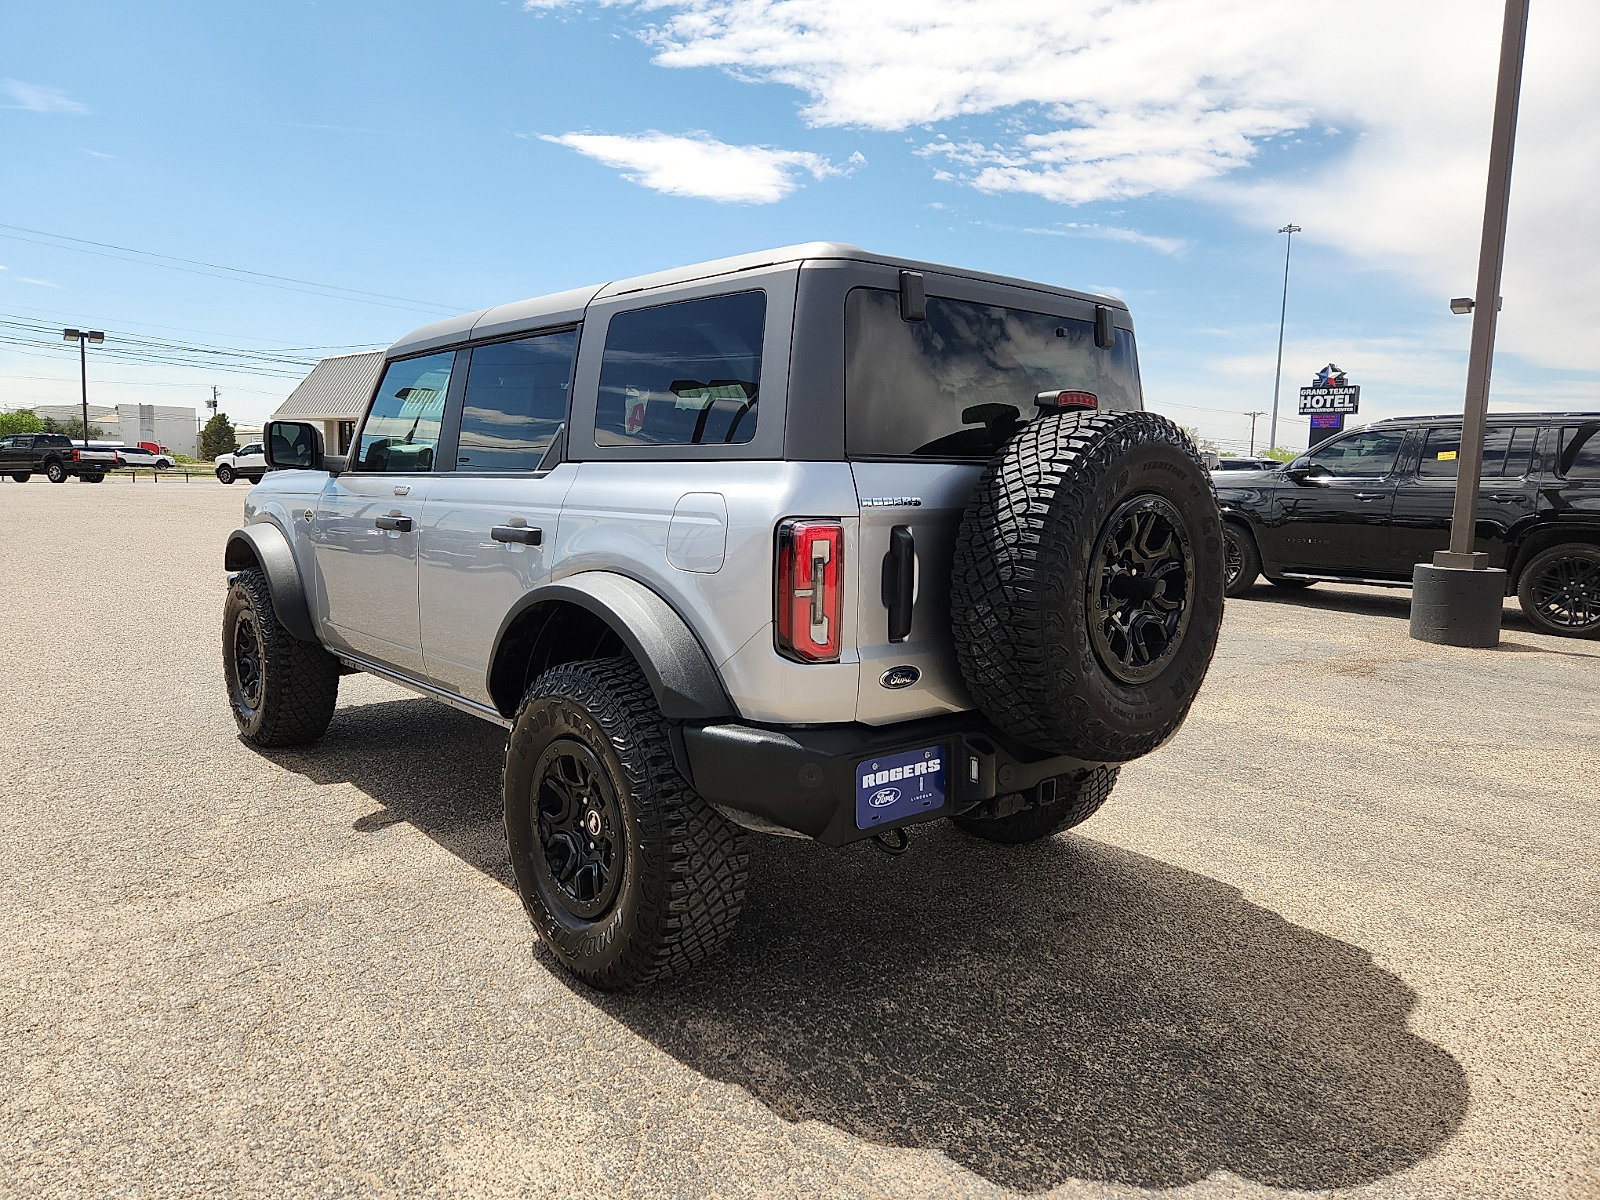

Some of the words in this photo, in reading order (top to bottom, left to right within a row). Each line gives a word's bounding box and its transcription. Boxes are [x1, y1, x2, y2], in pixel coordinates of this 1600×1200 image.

[1300, 395, 1353, 408] HOTEL
[514, 700, 606, 761] GOODYEAR
[862, 759, 941, 788] ROGERS
